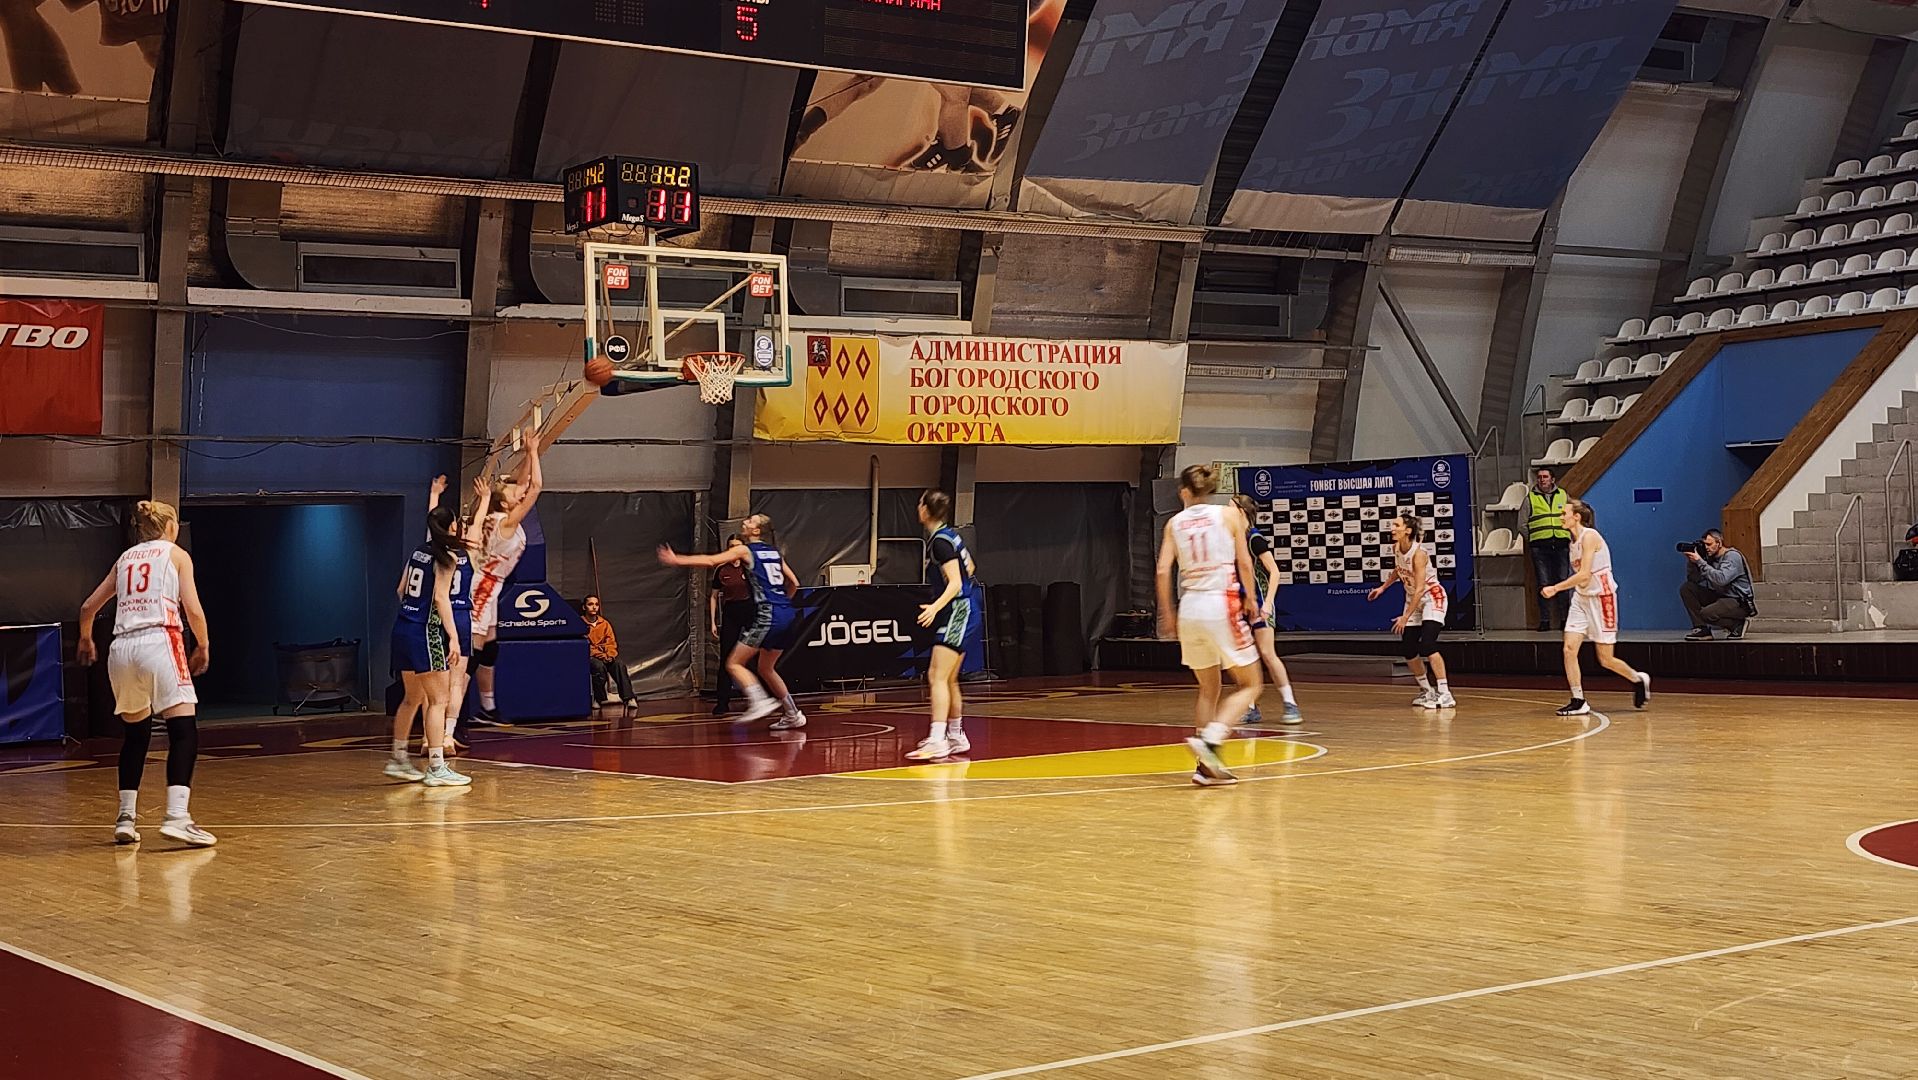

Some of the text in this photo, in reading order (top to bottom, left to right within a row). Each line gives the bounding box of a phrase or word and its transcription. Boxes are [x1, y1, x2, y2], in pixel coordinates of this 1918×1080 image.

[736, 6, 758, 41] 5
[586, 186, 607, 222] 11
[657, 189, 692, 222] 11
[607, 267, 627, 277] FON
[607, 276, 627, 286] BET
[752, 275, 771, 286] FON
[752, 285, 771, 295] BET
[608, 344, 626, 354] РФБ
[910, 340, 1122, 368] АДМИНИСТРАЦИЯ
[909, 367, 1100, 393] БОГОРОДСКОГО
[908, 395, 1070, 420] ГОРОДСКОГО
[907, 422, 1006, 444] ОКРУГА
[1338, 477, 1373, 490] ВЫСШАЯ
[1374, 476, 1394, 489] ЛИГА
[1188, 532, 1209, 562] 11
[125, 563, 151, 595] 13
[498, 618, 567, 628] Schelde Sports
[808, 615, 912, 647] JÖGEL
